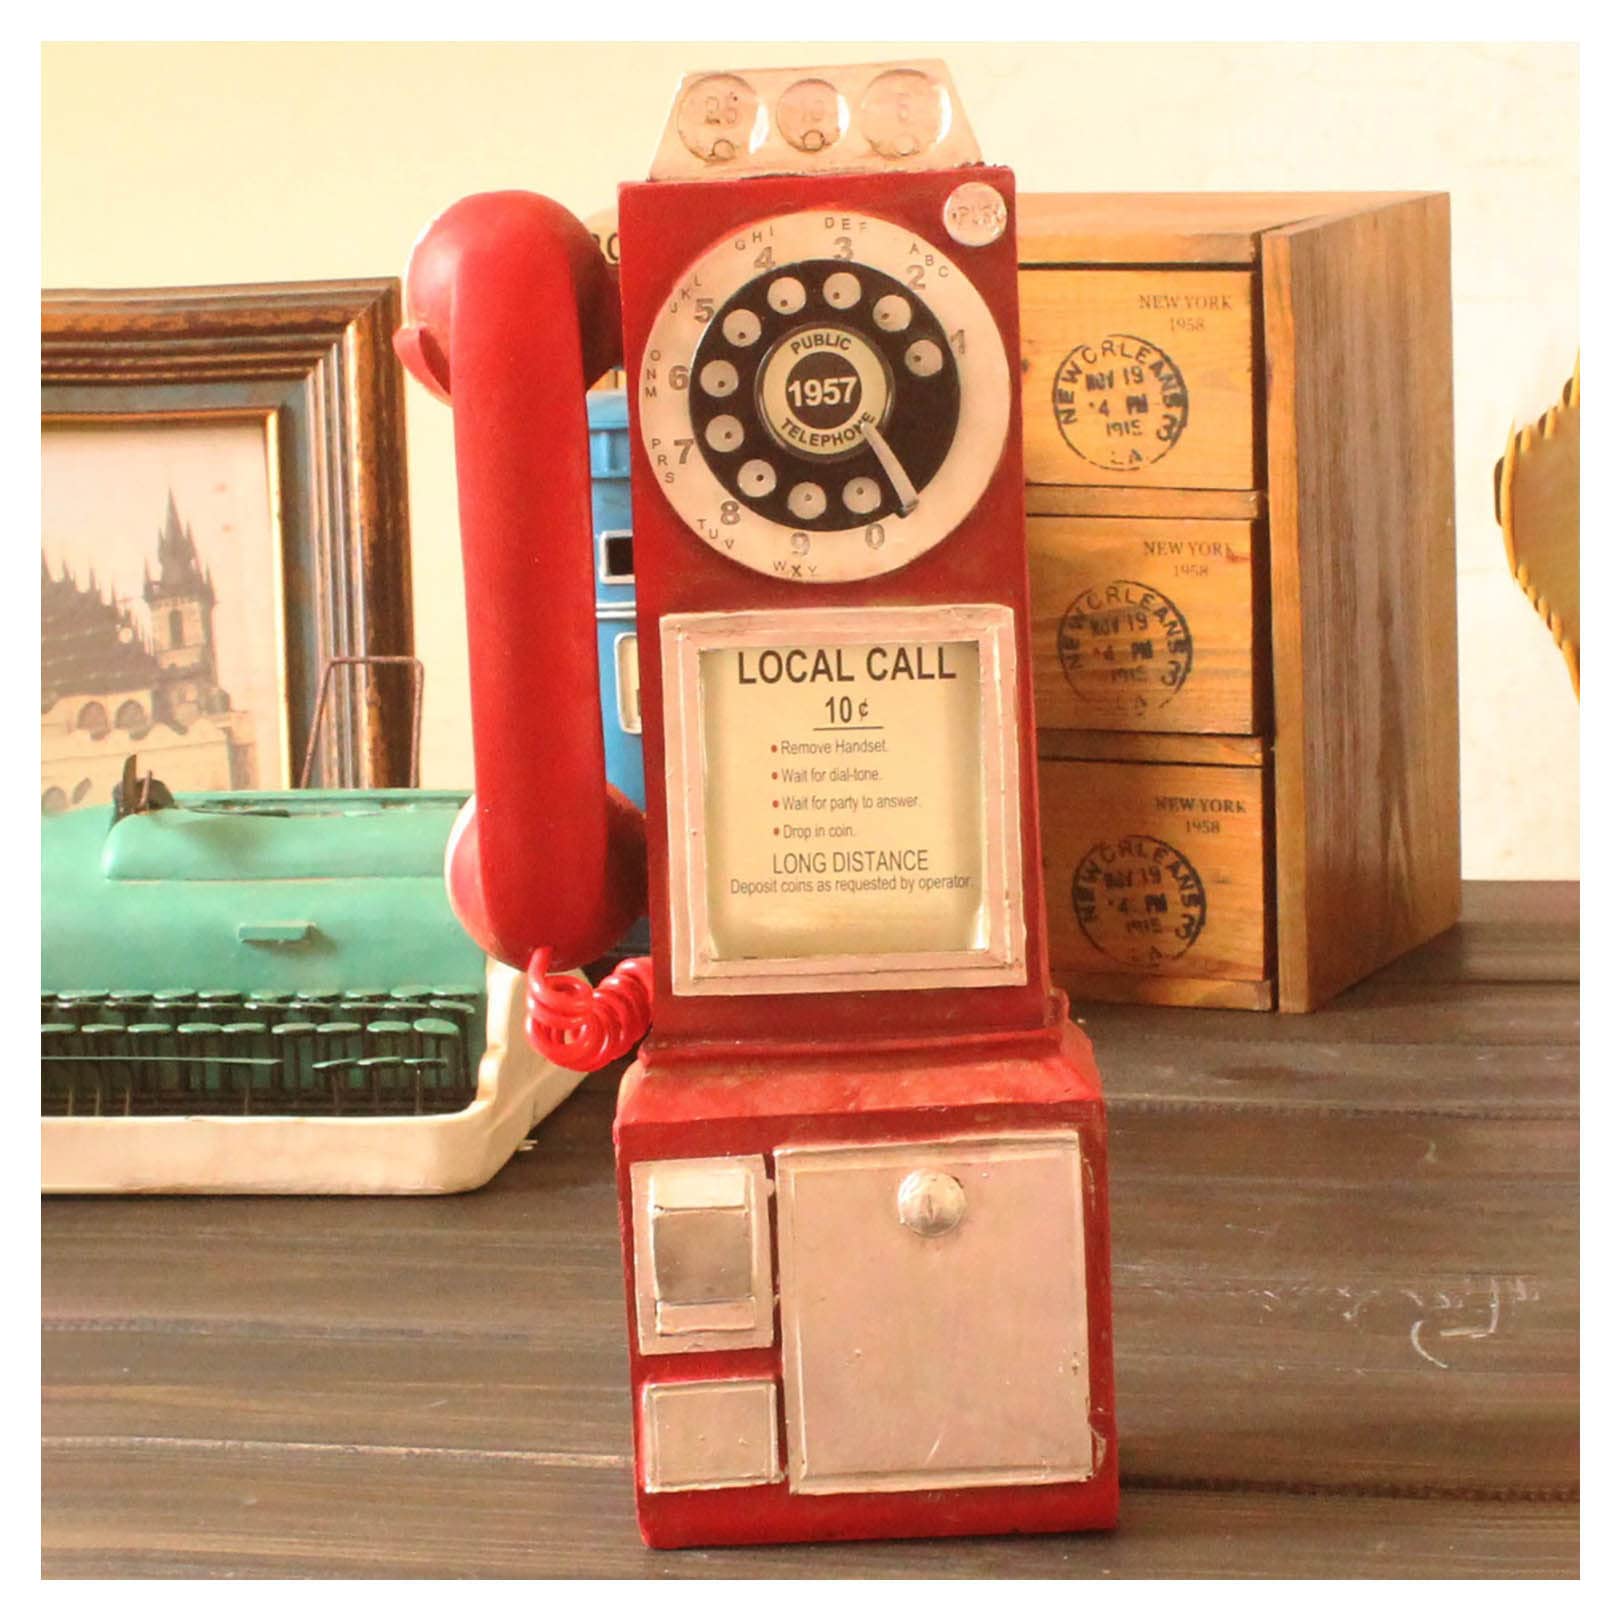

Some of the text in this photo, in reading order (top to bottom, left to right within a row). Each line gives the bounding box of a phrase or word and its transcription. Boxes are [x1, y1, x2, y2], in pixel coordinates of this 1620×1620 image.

[825, 217, 869, 232] DEF
[735, 226, 774, 251] GHI
[834, 236, 855, 261] 3
[753, 246, 776, 269] 4
[910, 243, 949, 277] ABC
[907, 265, 927, 290] 2
[670, 275, 702, 313] JKL
[1139, 295, 1232, 311] NEW YORK
[694, 298, 714, 323] 5
[790, 333, 852, 355] PUBLIC
[951, 329, 966, 355] 1
[668, 364, 689, 390] 6
[1123, 366, 1144, 385] 19
[787, 376, 858, 407] 1957
[1056, 360, 1083, 425] NEW
[652, 439, 675, 484] PRS
[673, 438, 694, 465] 7
[720, 500, 740, 525] 8
[697, 518, 735, 549] TUV
[791, 532, 811, 557] 9
[1144, 541, 1183, 556] NEW
[773, 560, 817, 577] WXY
[1128, 611, 1148, 631] 19
[737, 647, 957, 684] LOCAL CALL
[781, 739, 887, 755] Remove Handset.
[782, 767, 882, 783] Wait for dial-tone.
[782, 795, 922, 812] Wait for party to answer.
[1155, 796, 1247, 813] NEW YORK
[783, 824, 856, 840] Drop in coin.
[1186, 820, 1220, 834] 1958
[773, 849, 928, 874] LONG DISTANCE
[731, 875, 974, 895] Deposit coins as requested by operator.
